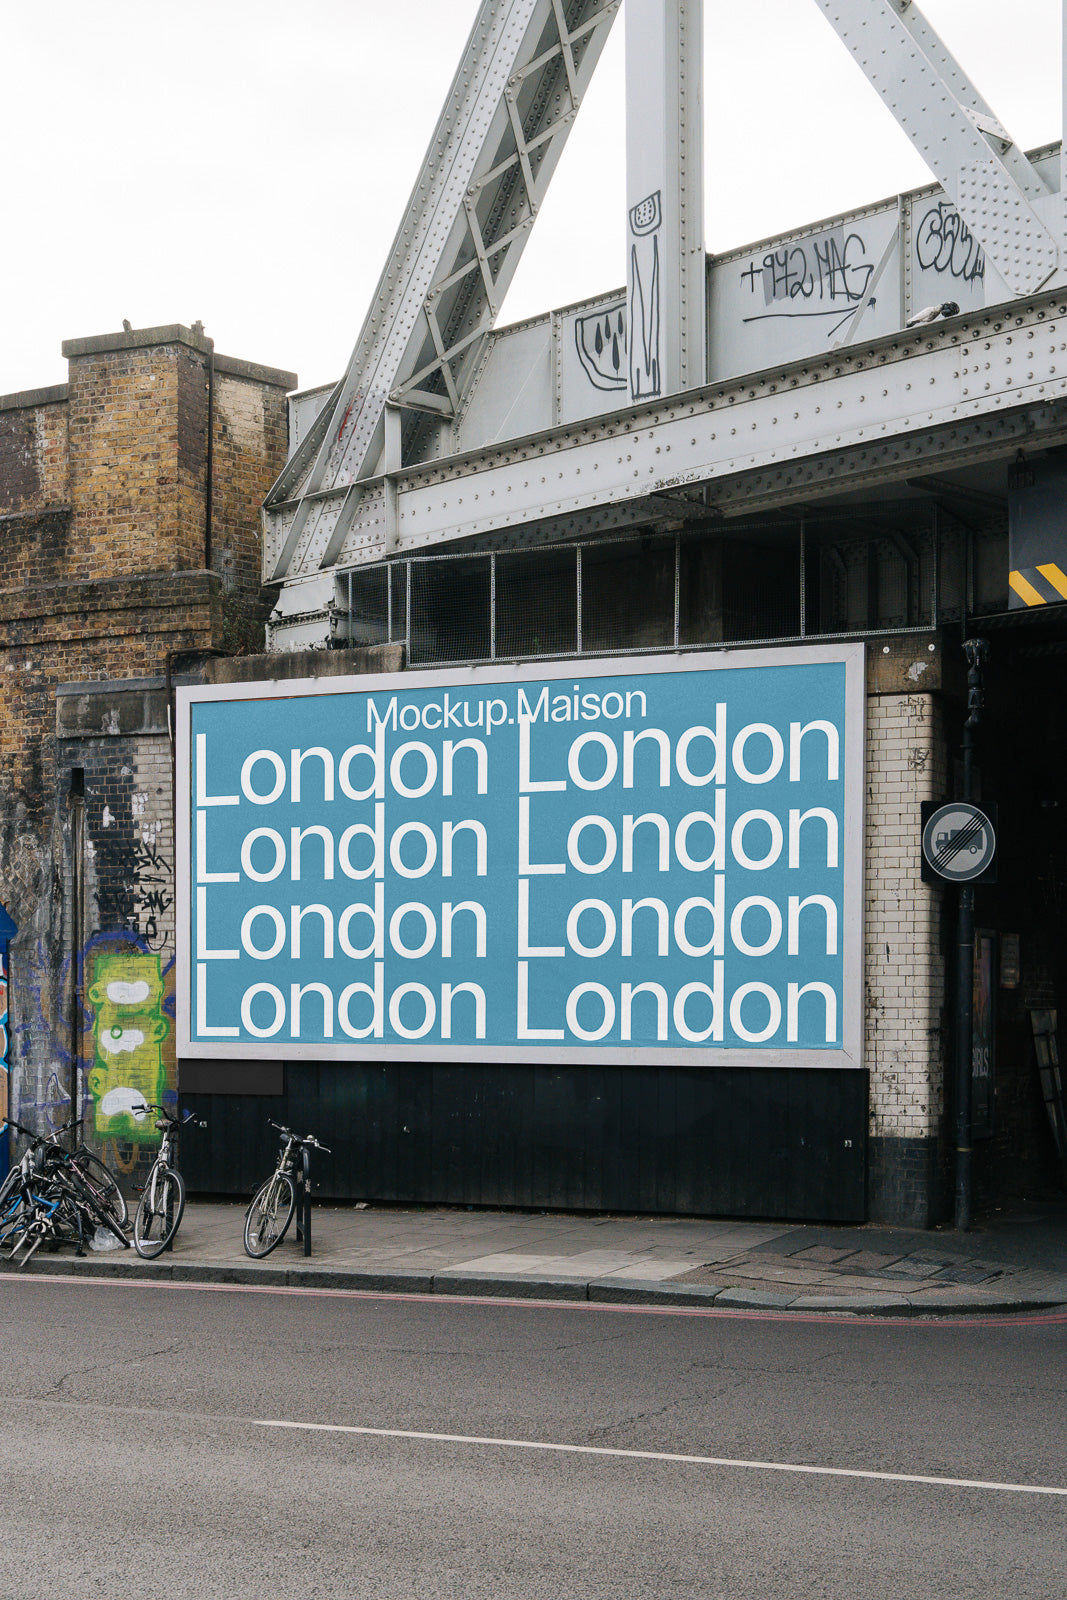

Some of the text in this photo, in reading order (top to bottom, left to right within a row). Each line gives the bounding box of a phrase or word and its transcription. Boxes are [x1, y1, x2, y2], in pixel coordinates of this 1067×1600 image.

[367, 685, 647, 735] Mockup.Maison
[197, 703, 839, 806] London London
[197, 789, 838, 883] London London
[197, 882, 486, 960] London
[517, 874, 837, 957] London
[197, 960, 836, 1042] London London
